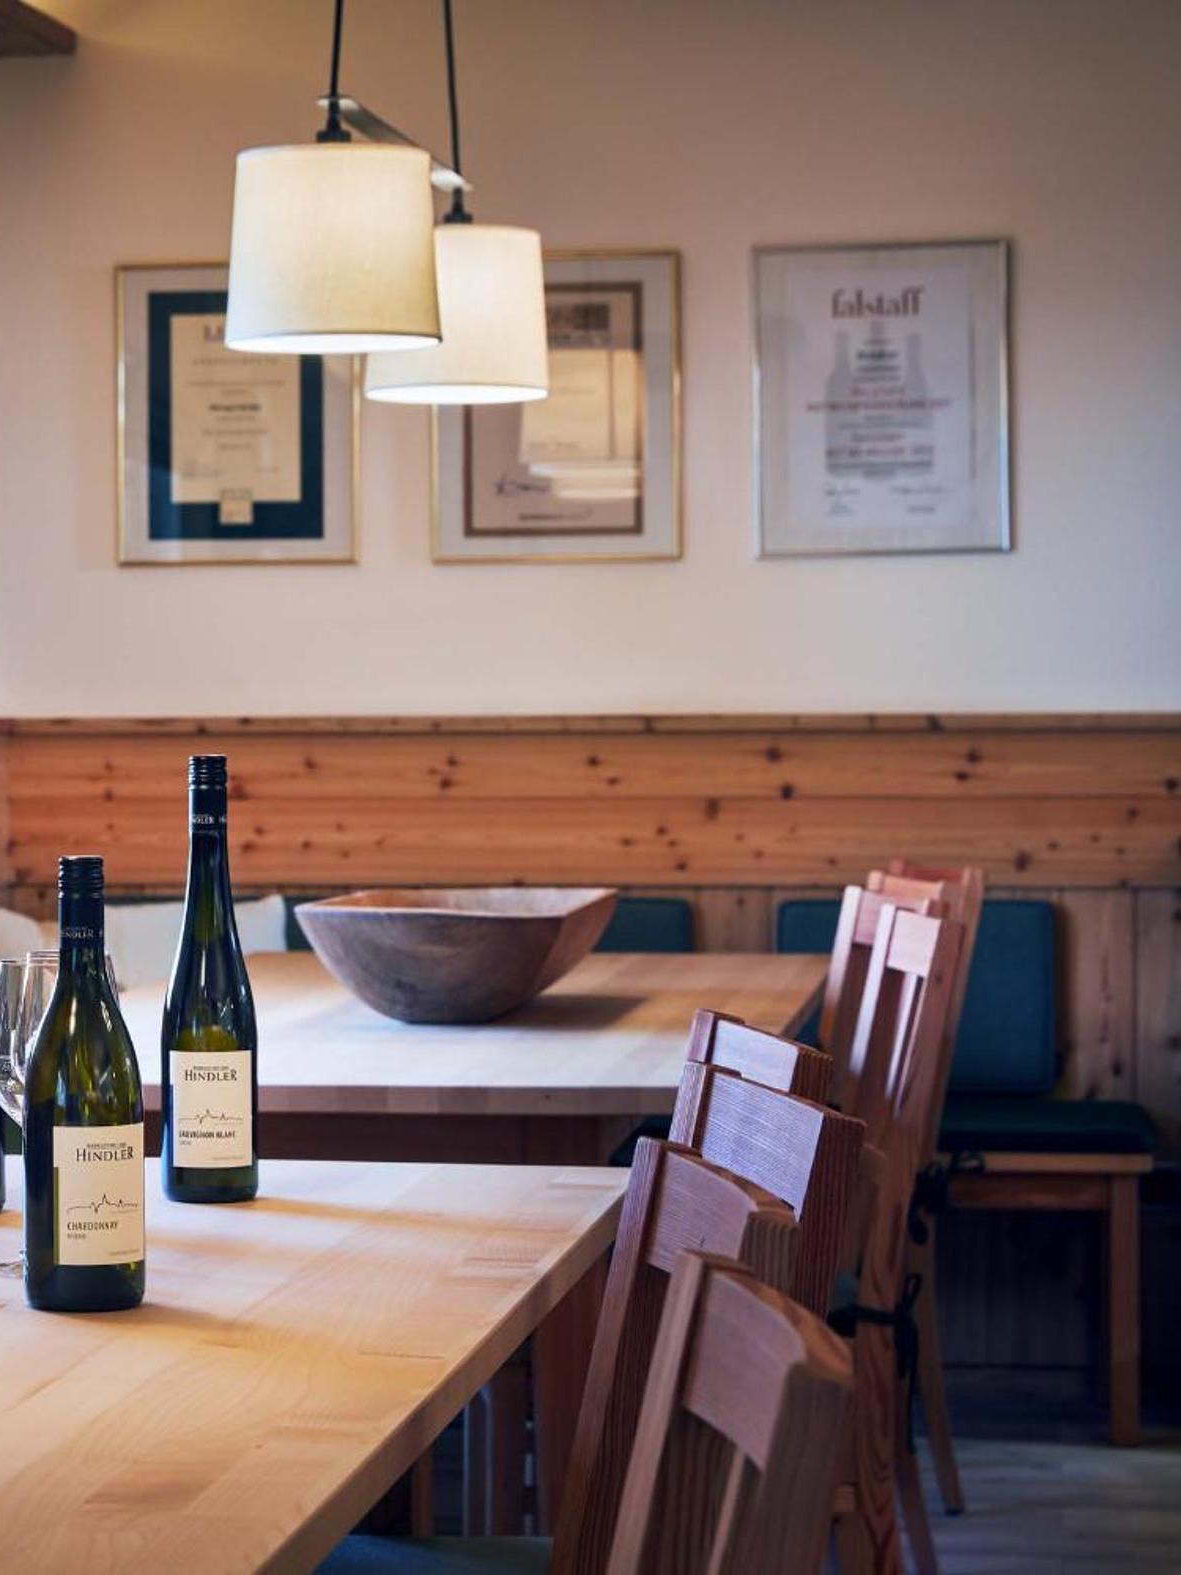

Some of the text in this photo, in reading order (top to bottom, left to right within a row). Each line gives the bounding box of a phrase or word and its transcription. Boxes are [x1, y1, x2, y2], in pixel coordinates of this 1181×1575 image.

[831, 285, 924, 318] falstaff
[184, 1069, 237, 1082] HINDLER
[76, 1146, 134, 1162] HINDLER
